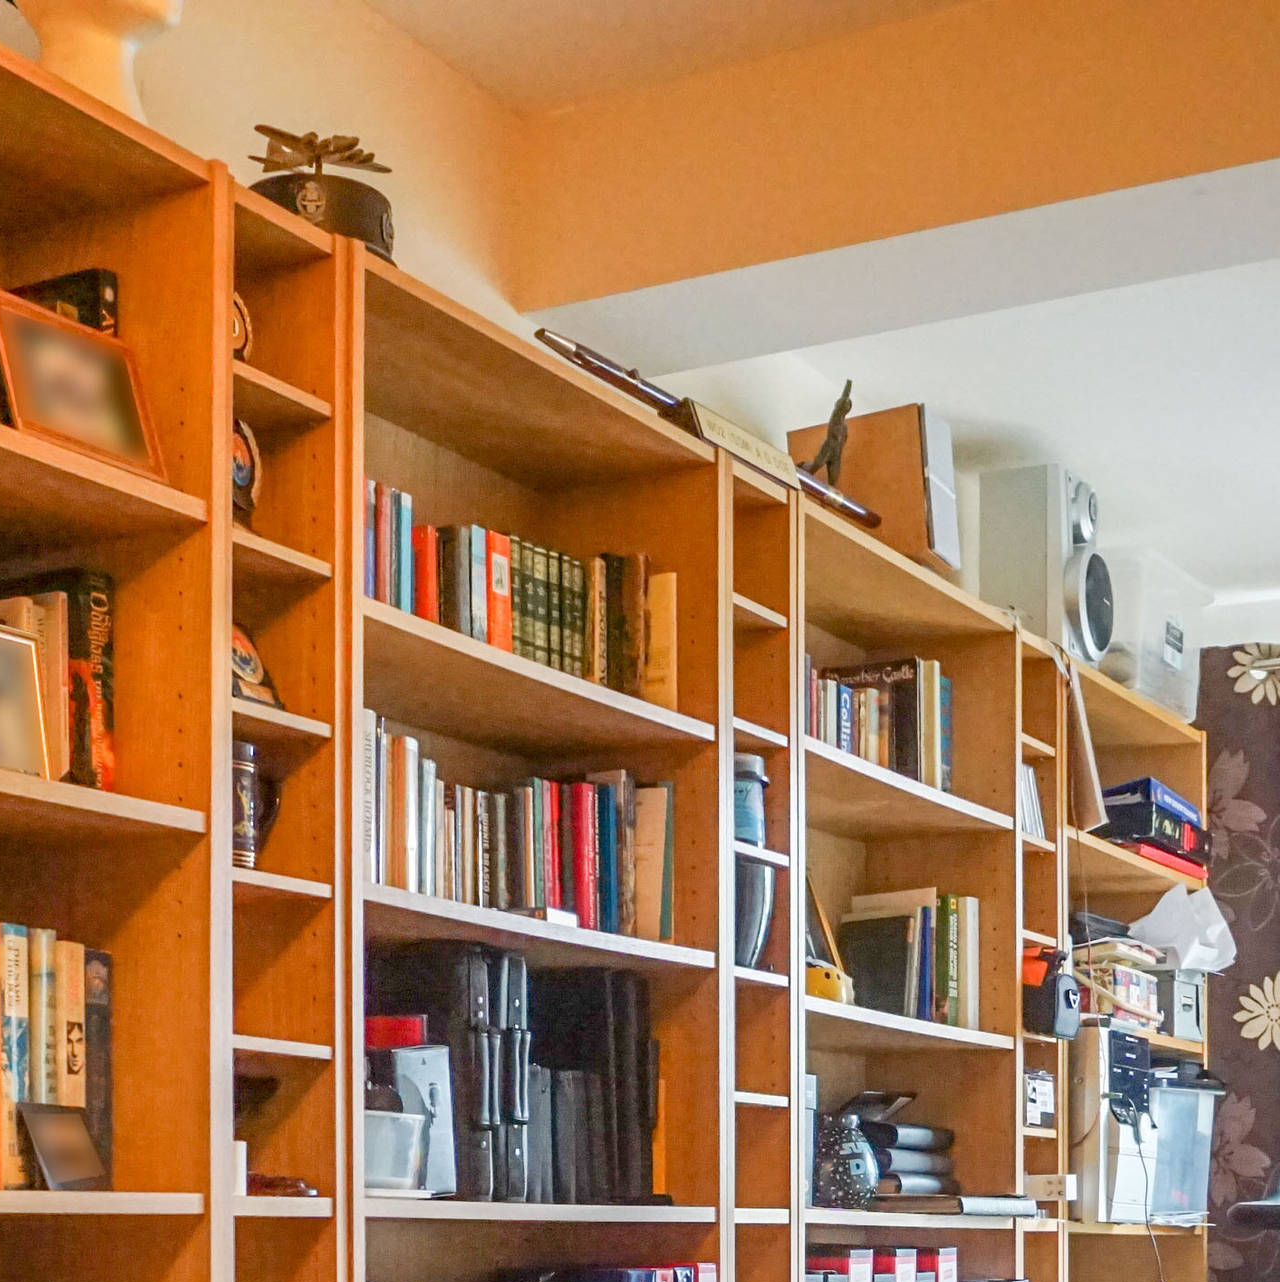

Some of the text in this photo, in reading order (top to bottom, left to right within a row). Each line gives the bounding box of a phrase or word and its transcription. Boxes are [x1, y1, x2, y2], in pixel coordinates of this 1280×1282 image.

[598, 589, 607, 685] ACKBOOT
[363, 730, 373, 855] SHERLOCK HOLMES
